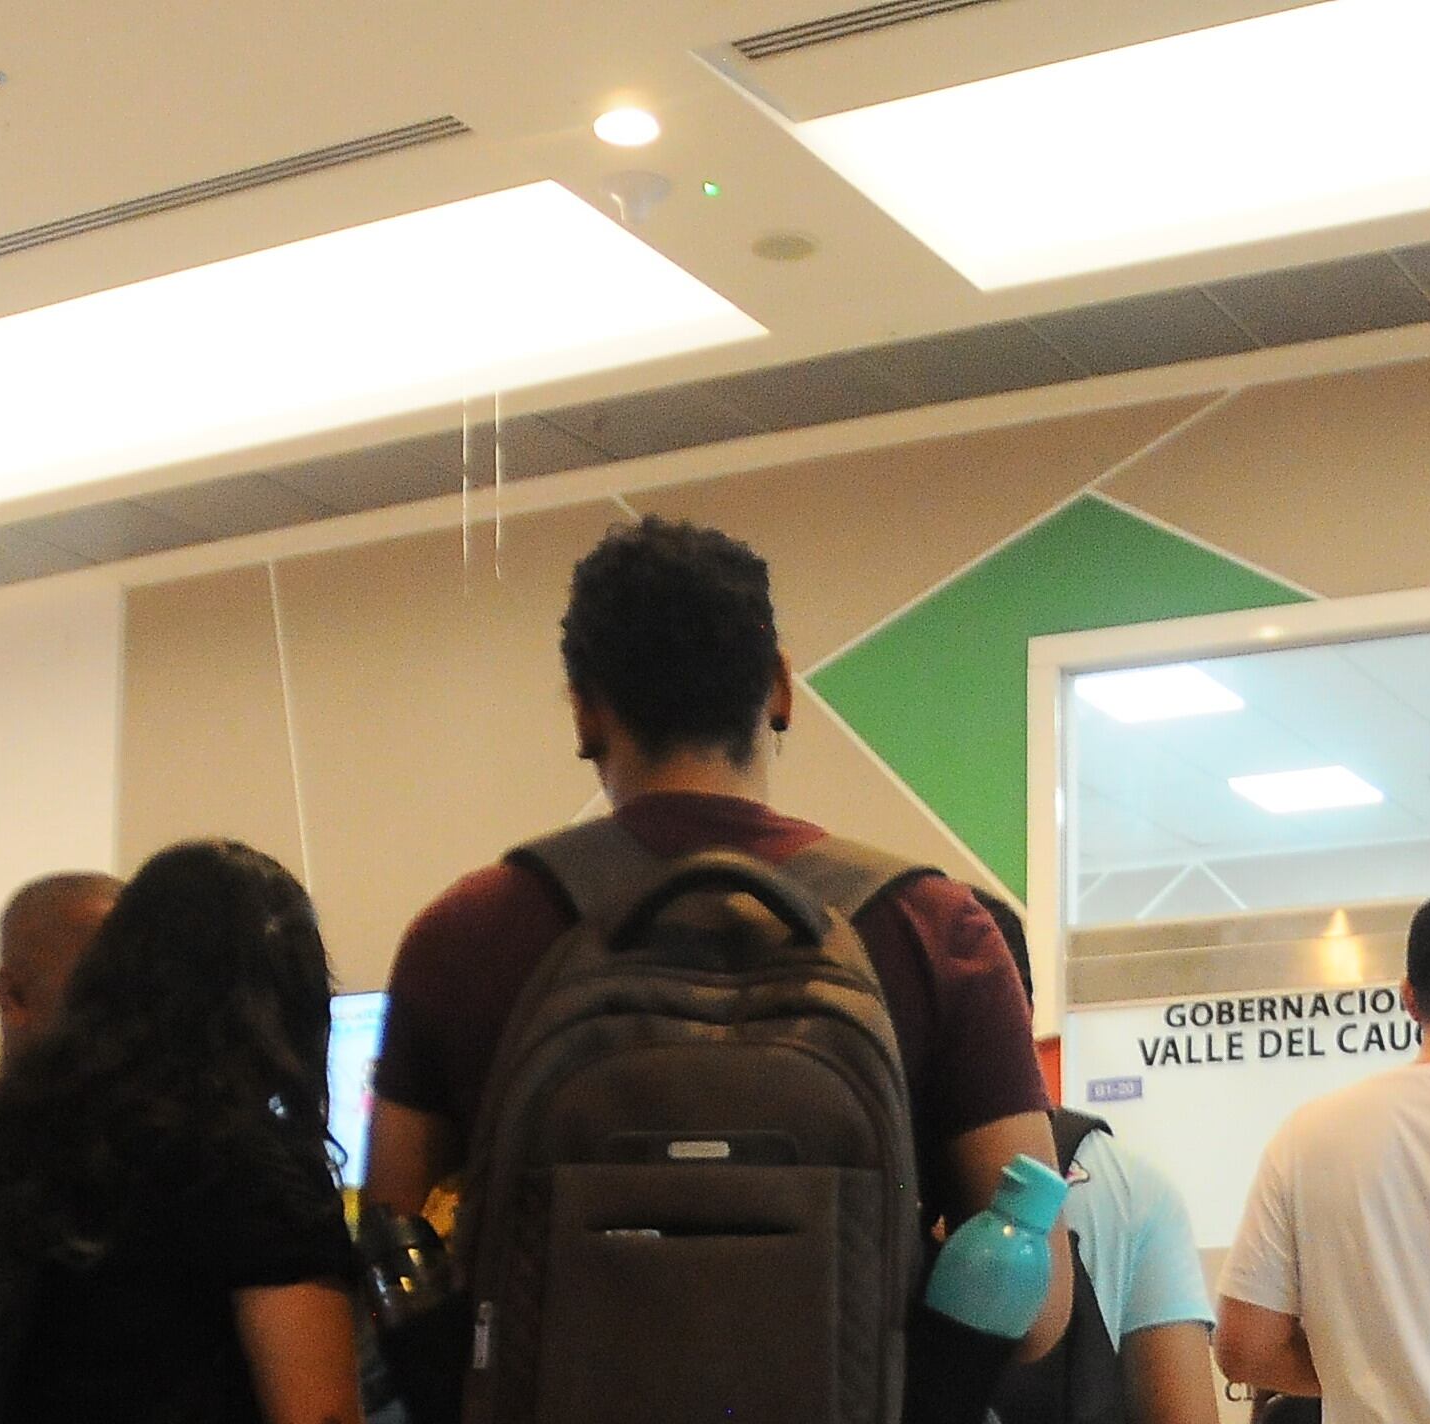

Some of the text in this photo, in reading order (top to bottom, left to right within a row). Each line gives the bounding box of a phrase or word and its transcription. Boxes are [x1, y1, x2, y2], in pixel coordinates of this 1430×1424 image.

[1165, 988, 1406, 1028] GOBERNACIO
[1137, 1020, 1422, 1066] VALLE DEL CAU
